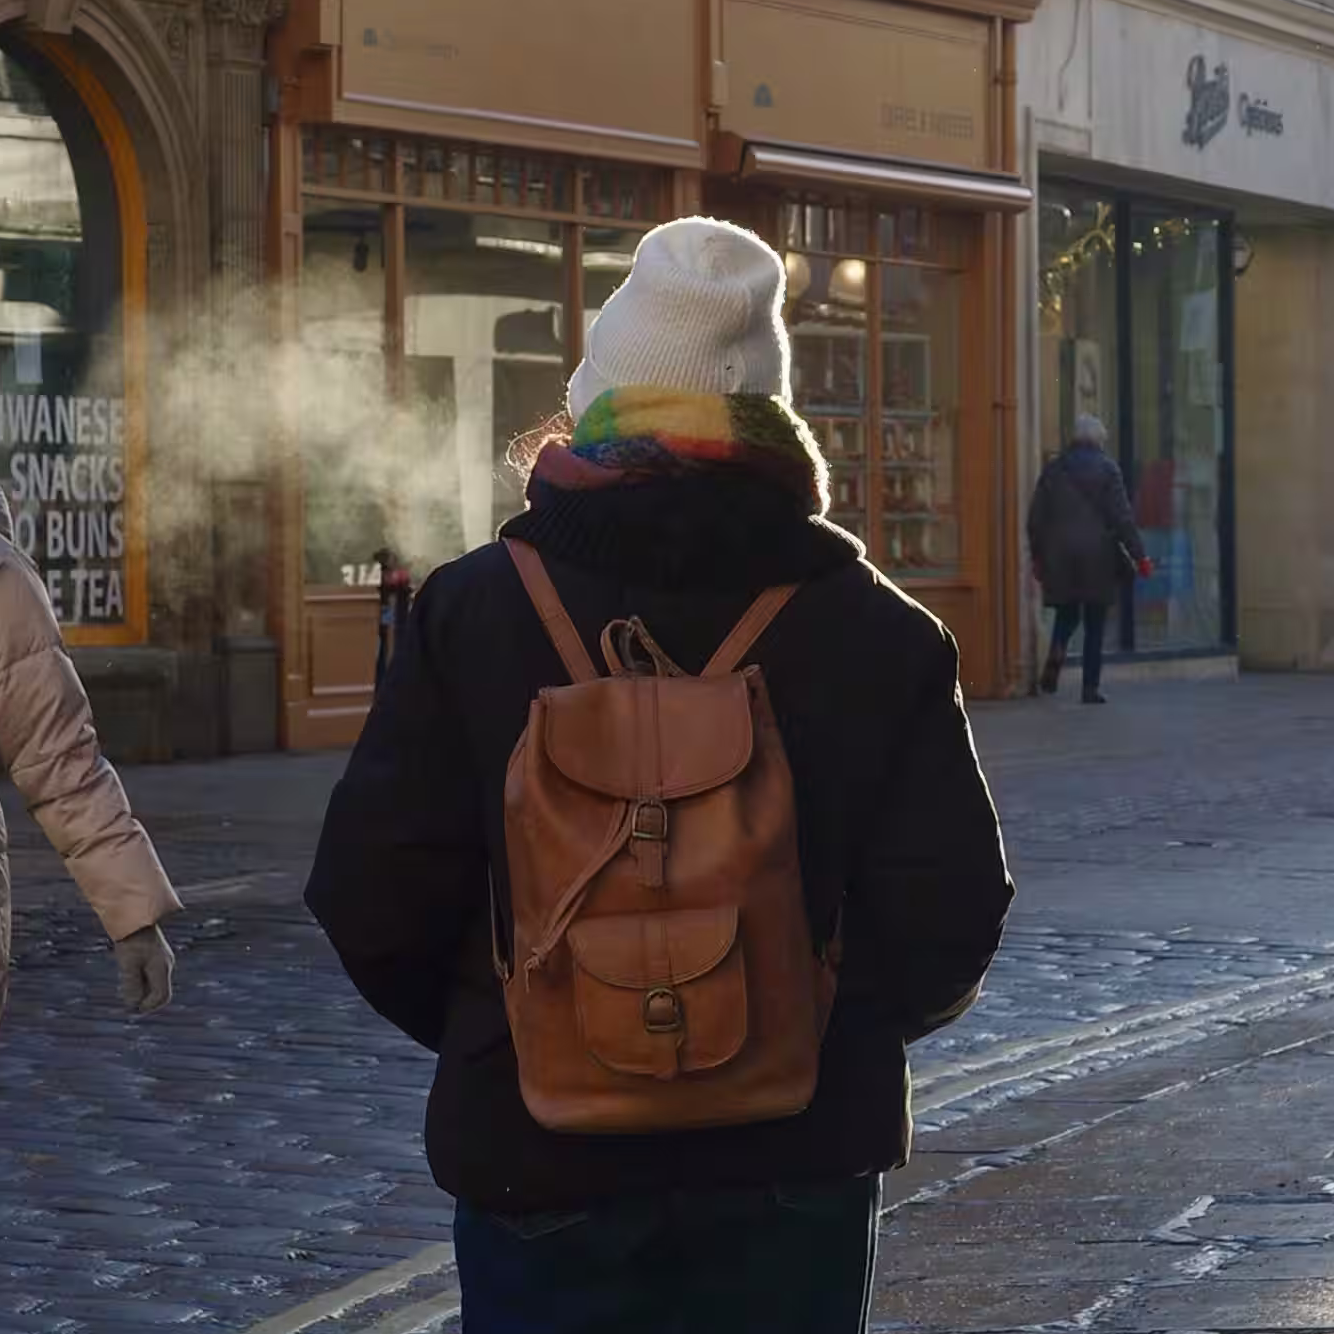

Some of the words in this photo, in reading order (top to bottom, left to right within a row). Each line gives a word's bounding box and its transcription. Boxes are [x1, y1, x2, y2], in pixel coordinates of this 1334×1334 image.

[10, 451, 125, 502] SNACKS
[46, 510, 124, 559] BUNS
[70, 569, 124, 617] TEA
